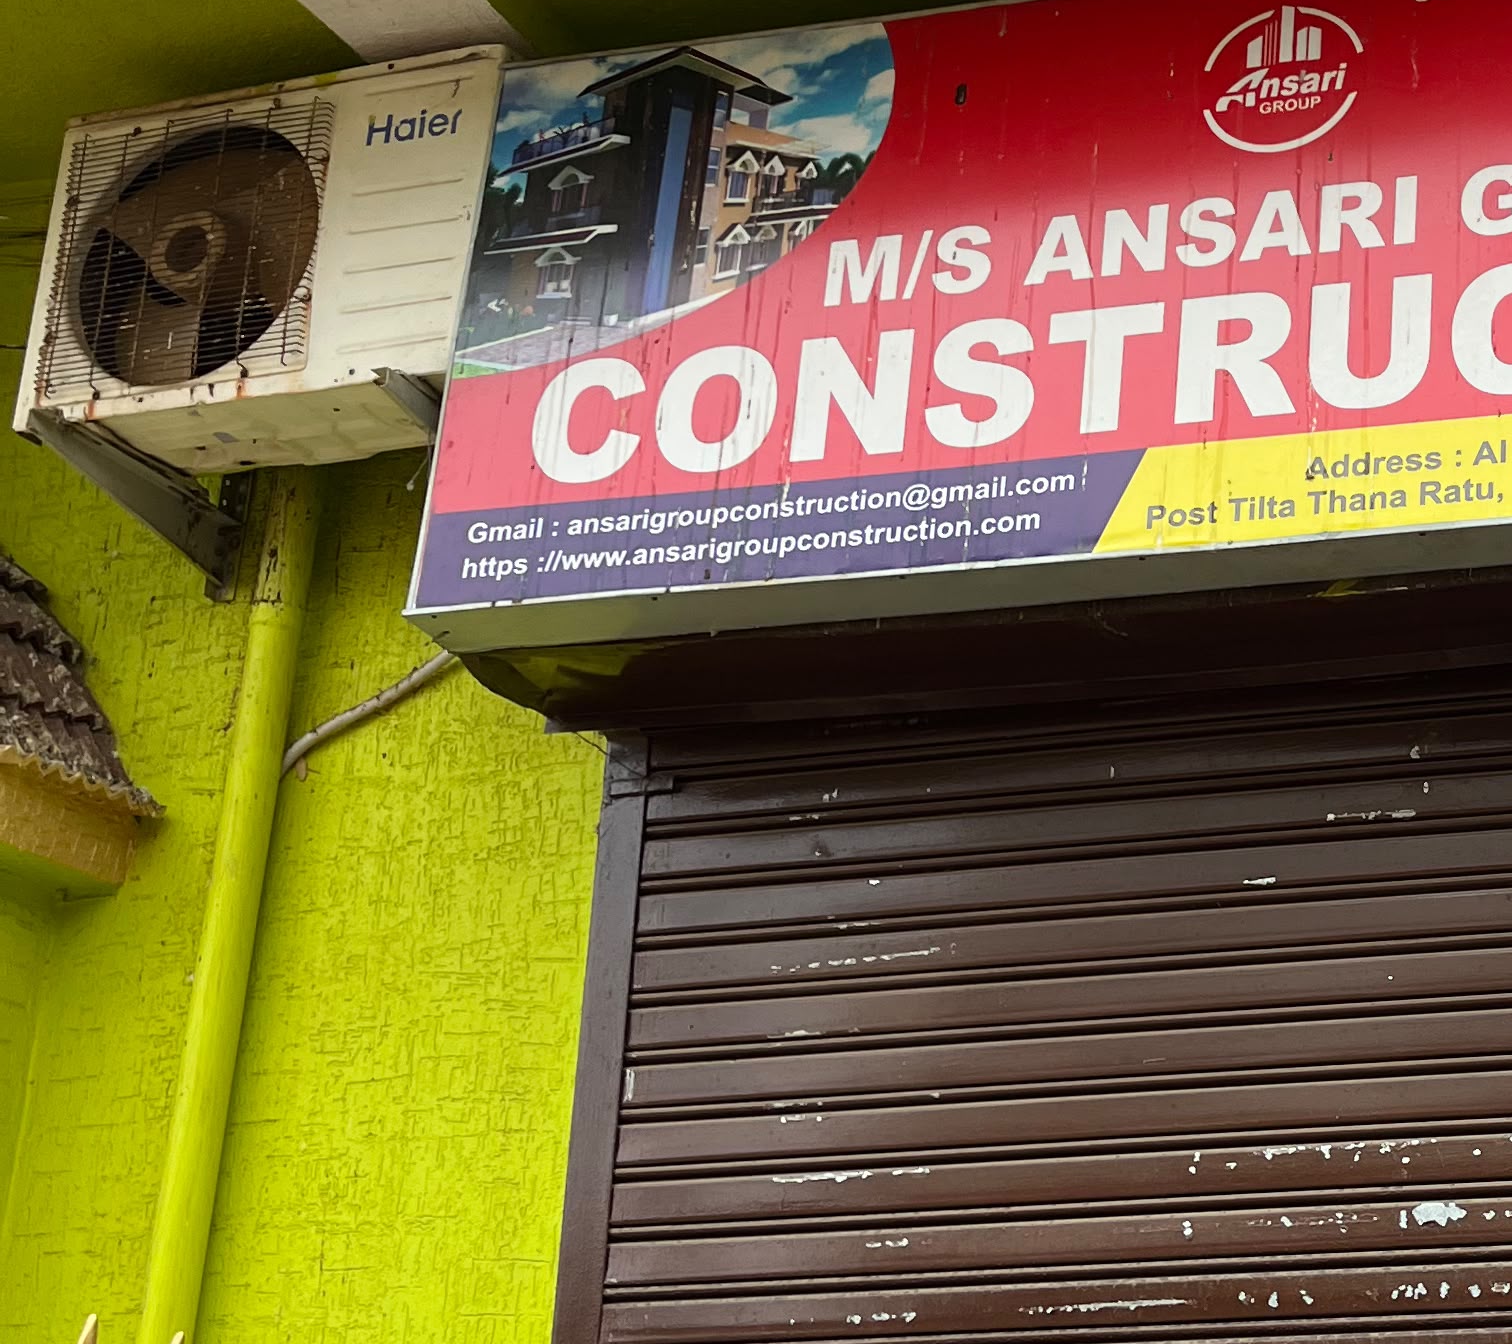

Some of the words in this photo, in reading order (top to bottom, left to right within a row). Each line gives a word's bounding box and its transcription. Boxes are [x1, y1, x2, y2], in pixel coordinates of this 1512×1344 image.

[1216, 62, 1347, 112] Ansari
[1259, 95, 1321, 114] GROUP
[366, 108, 463, 146] Haier
[824, 224, 992, 307] M/S
[1023, 175, 1419, 286] ANSARI
[1307, 451, 1442, 482] Address
[1472, 439, 1507, 466] Al
[467, 516, 544, 544] Gmail
[567, 473, 1076, 535] ansarigroupconstruction@gmail.com
[1146, 502, 1218, 530] Post
[1228, 494, 1296, 523] Tilta
[1307, 489, 1407, 516] Thana
[1419, 478, 1505, 506] Ratu,
[461, 556, 529, 582] https
